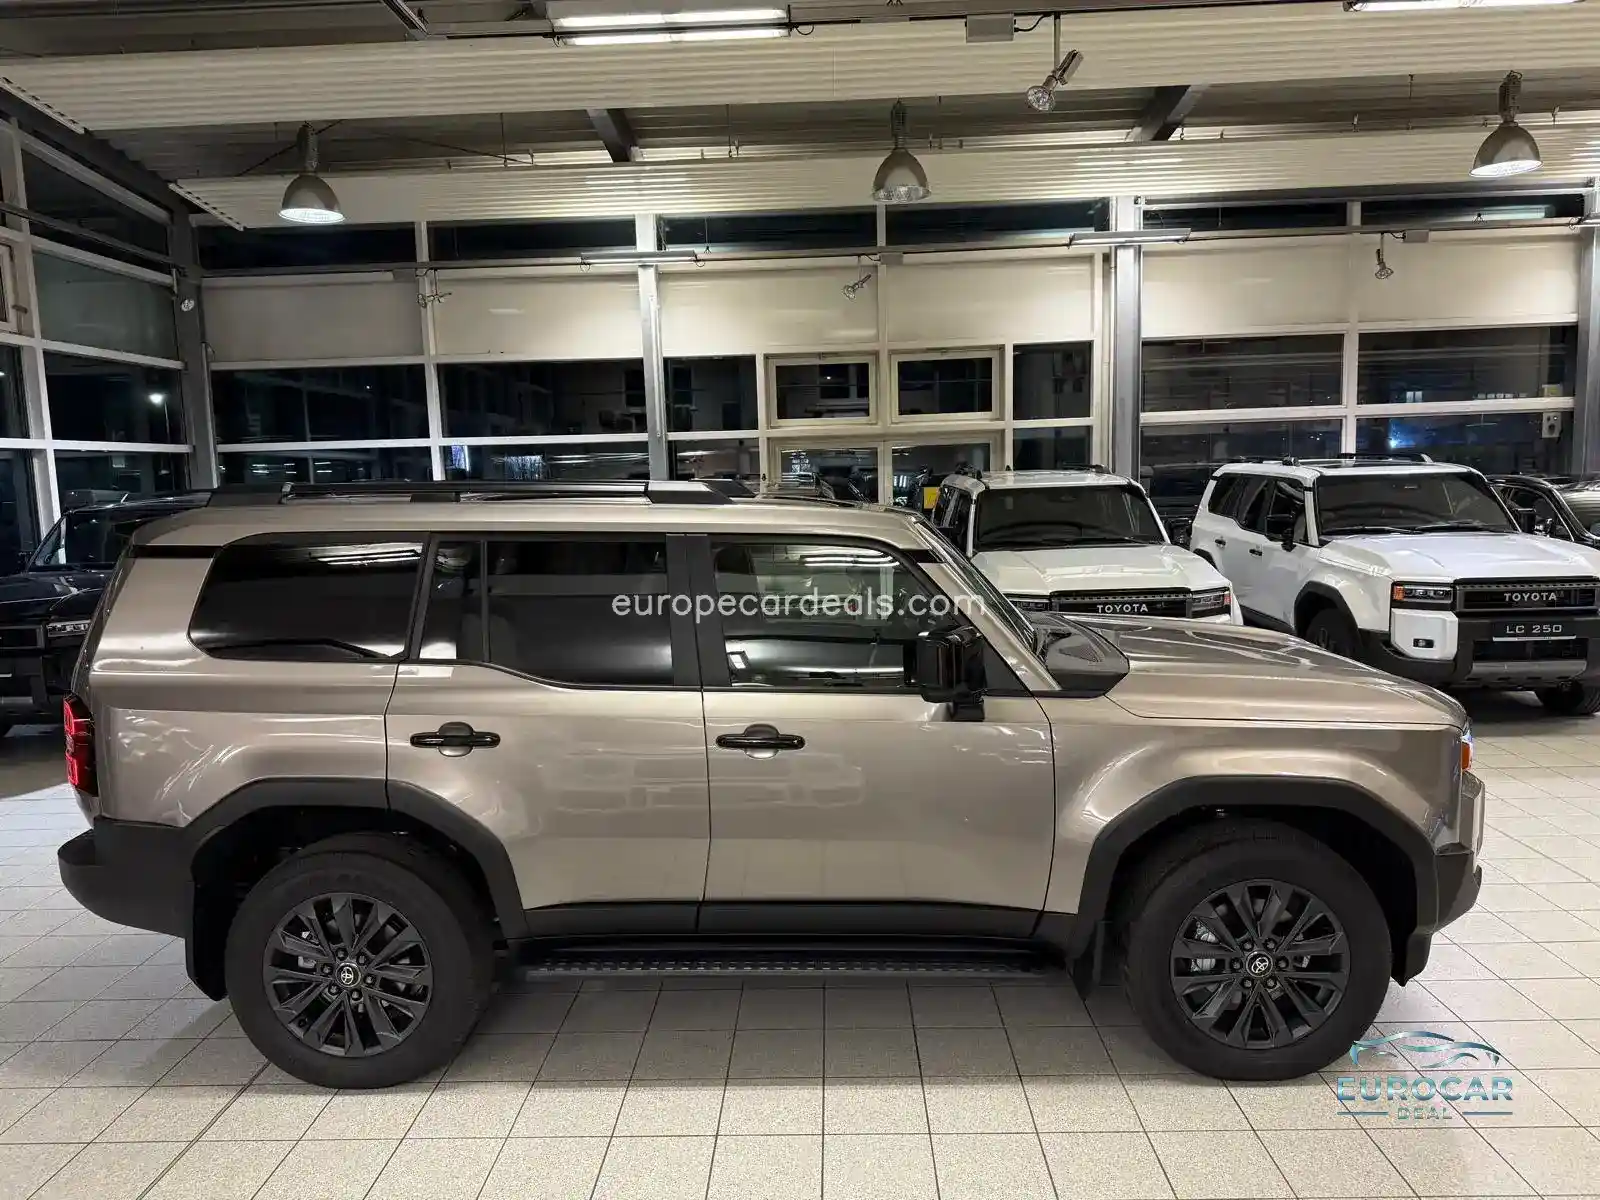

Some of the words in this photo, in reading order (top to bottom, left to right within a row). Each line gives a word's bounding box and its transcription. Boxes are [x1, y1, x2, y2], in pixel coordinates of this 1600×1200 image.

[1504, 592, 1557, 602] TOYOTA
[1096, 603, 1149, 614] TOYOTA
[1506, 624, 1525, 634] LC
[1532, 624, 1562, 633] 250
